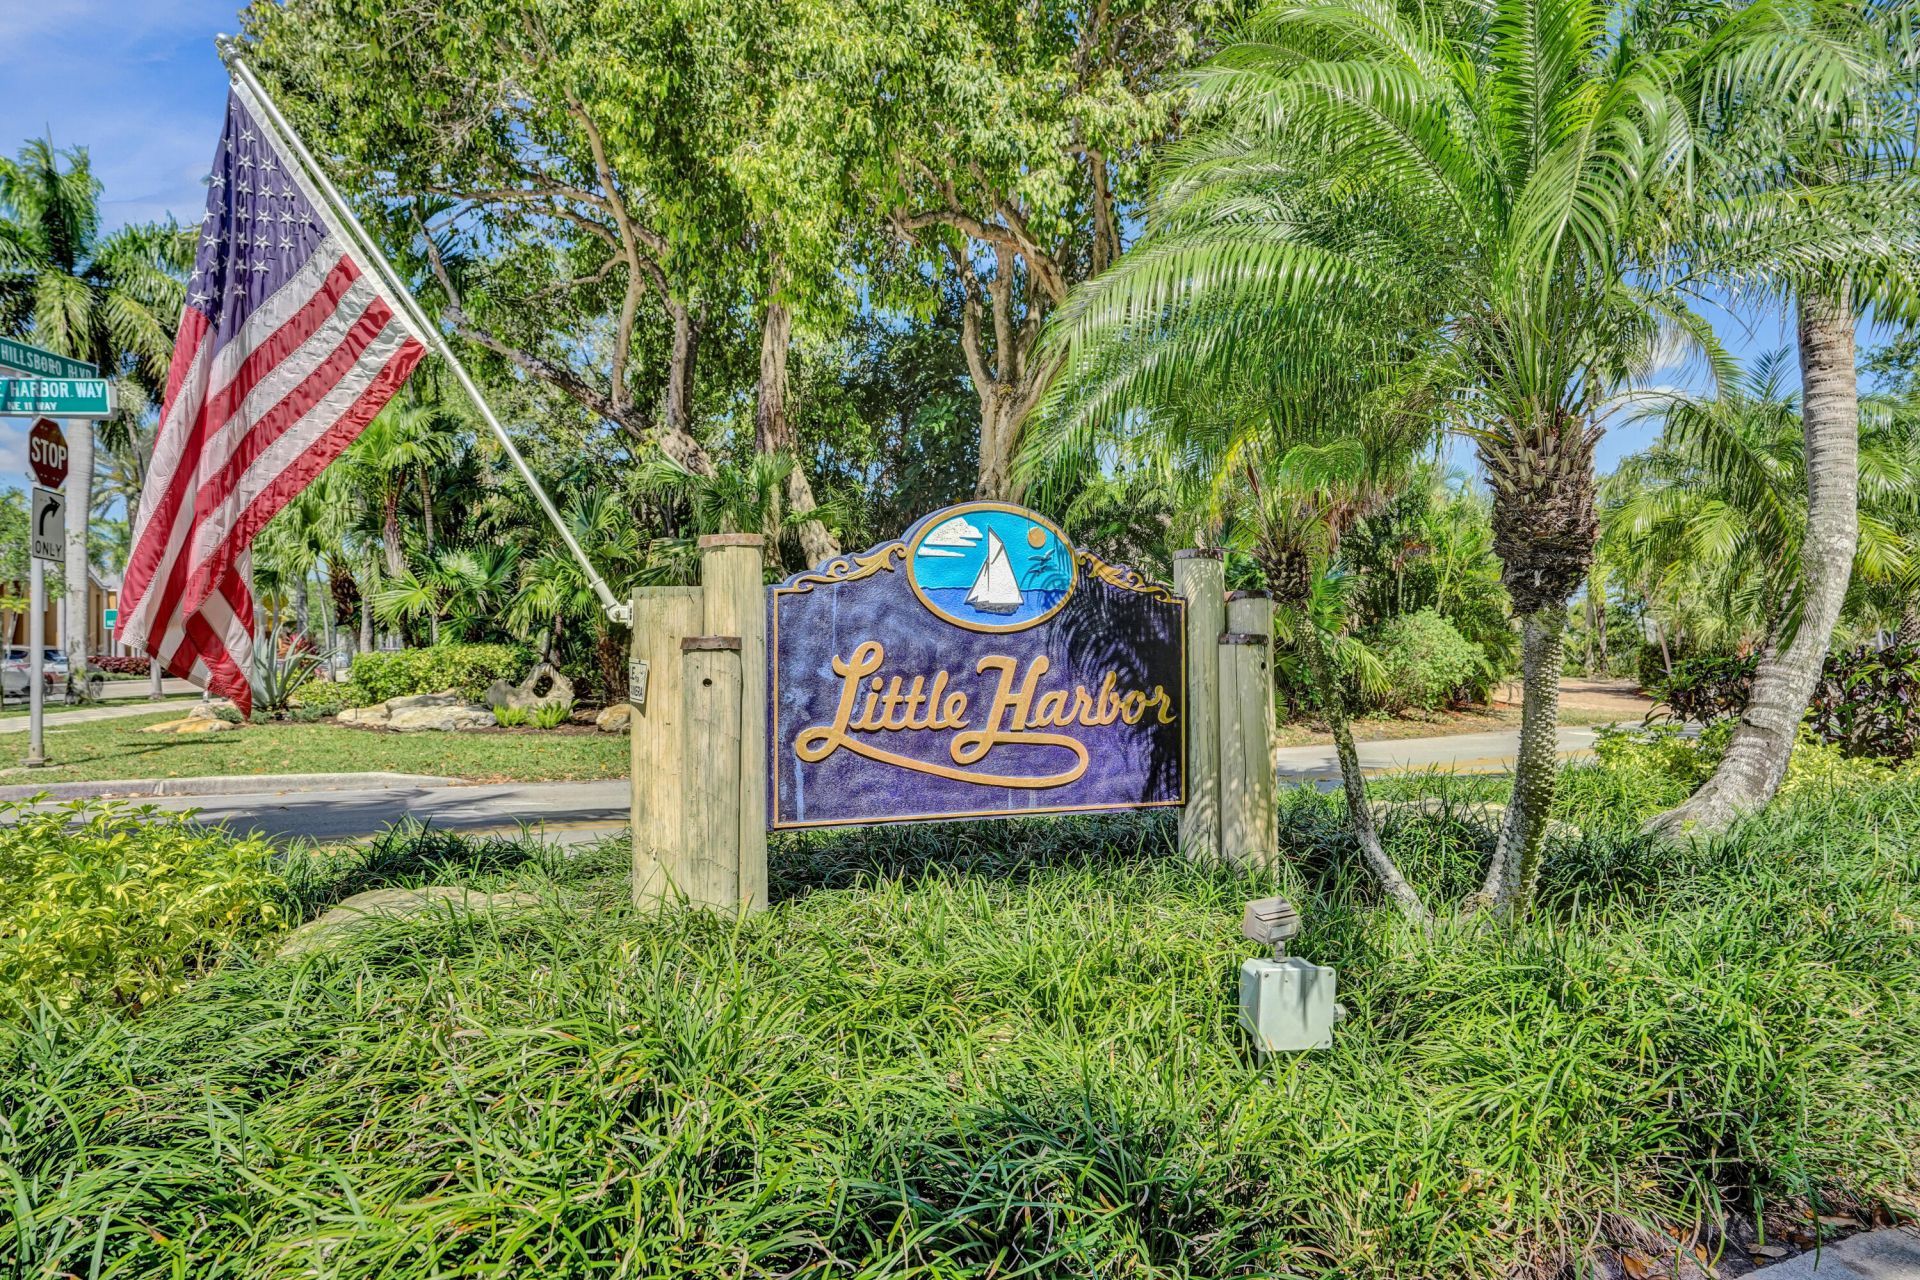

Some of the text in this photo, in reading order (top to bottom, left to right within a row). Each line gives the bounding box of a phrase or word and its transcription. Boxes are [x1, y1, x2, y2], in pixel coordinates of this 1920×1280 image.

[0, 343, 62, 377] HILLSBORO
[75, 382, 104, 398] WAY
[7, 401, 21, 411] NE
[36, 401, 57, 411] WAY
[31, 436, 68, 470] STOP
[34, 540, 62, 557] ONLY
[795, 641, 1177, 766] Little Harbor
